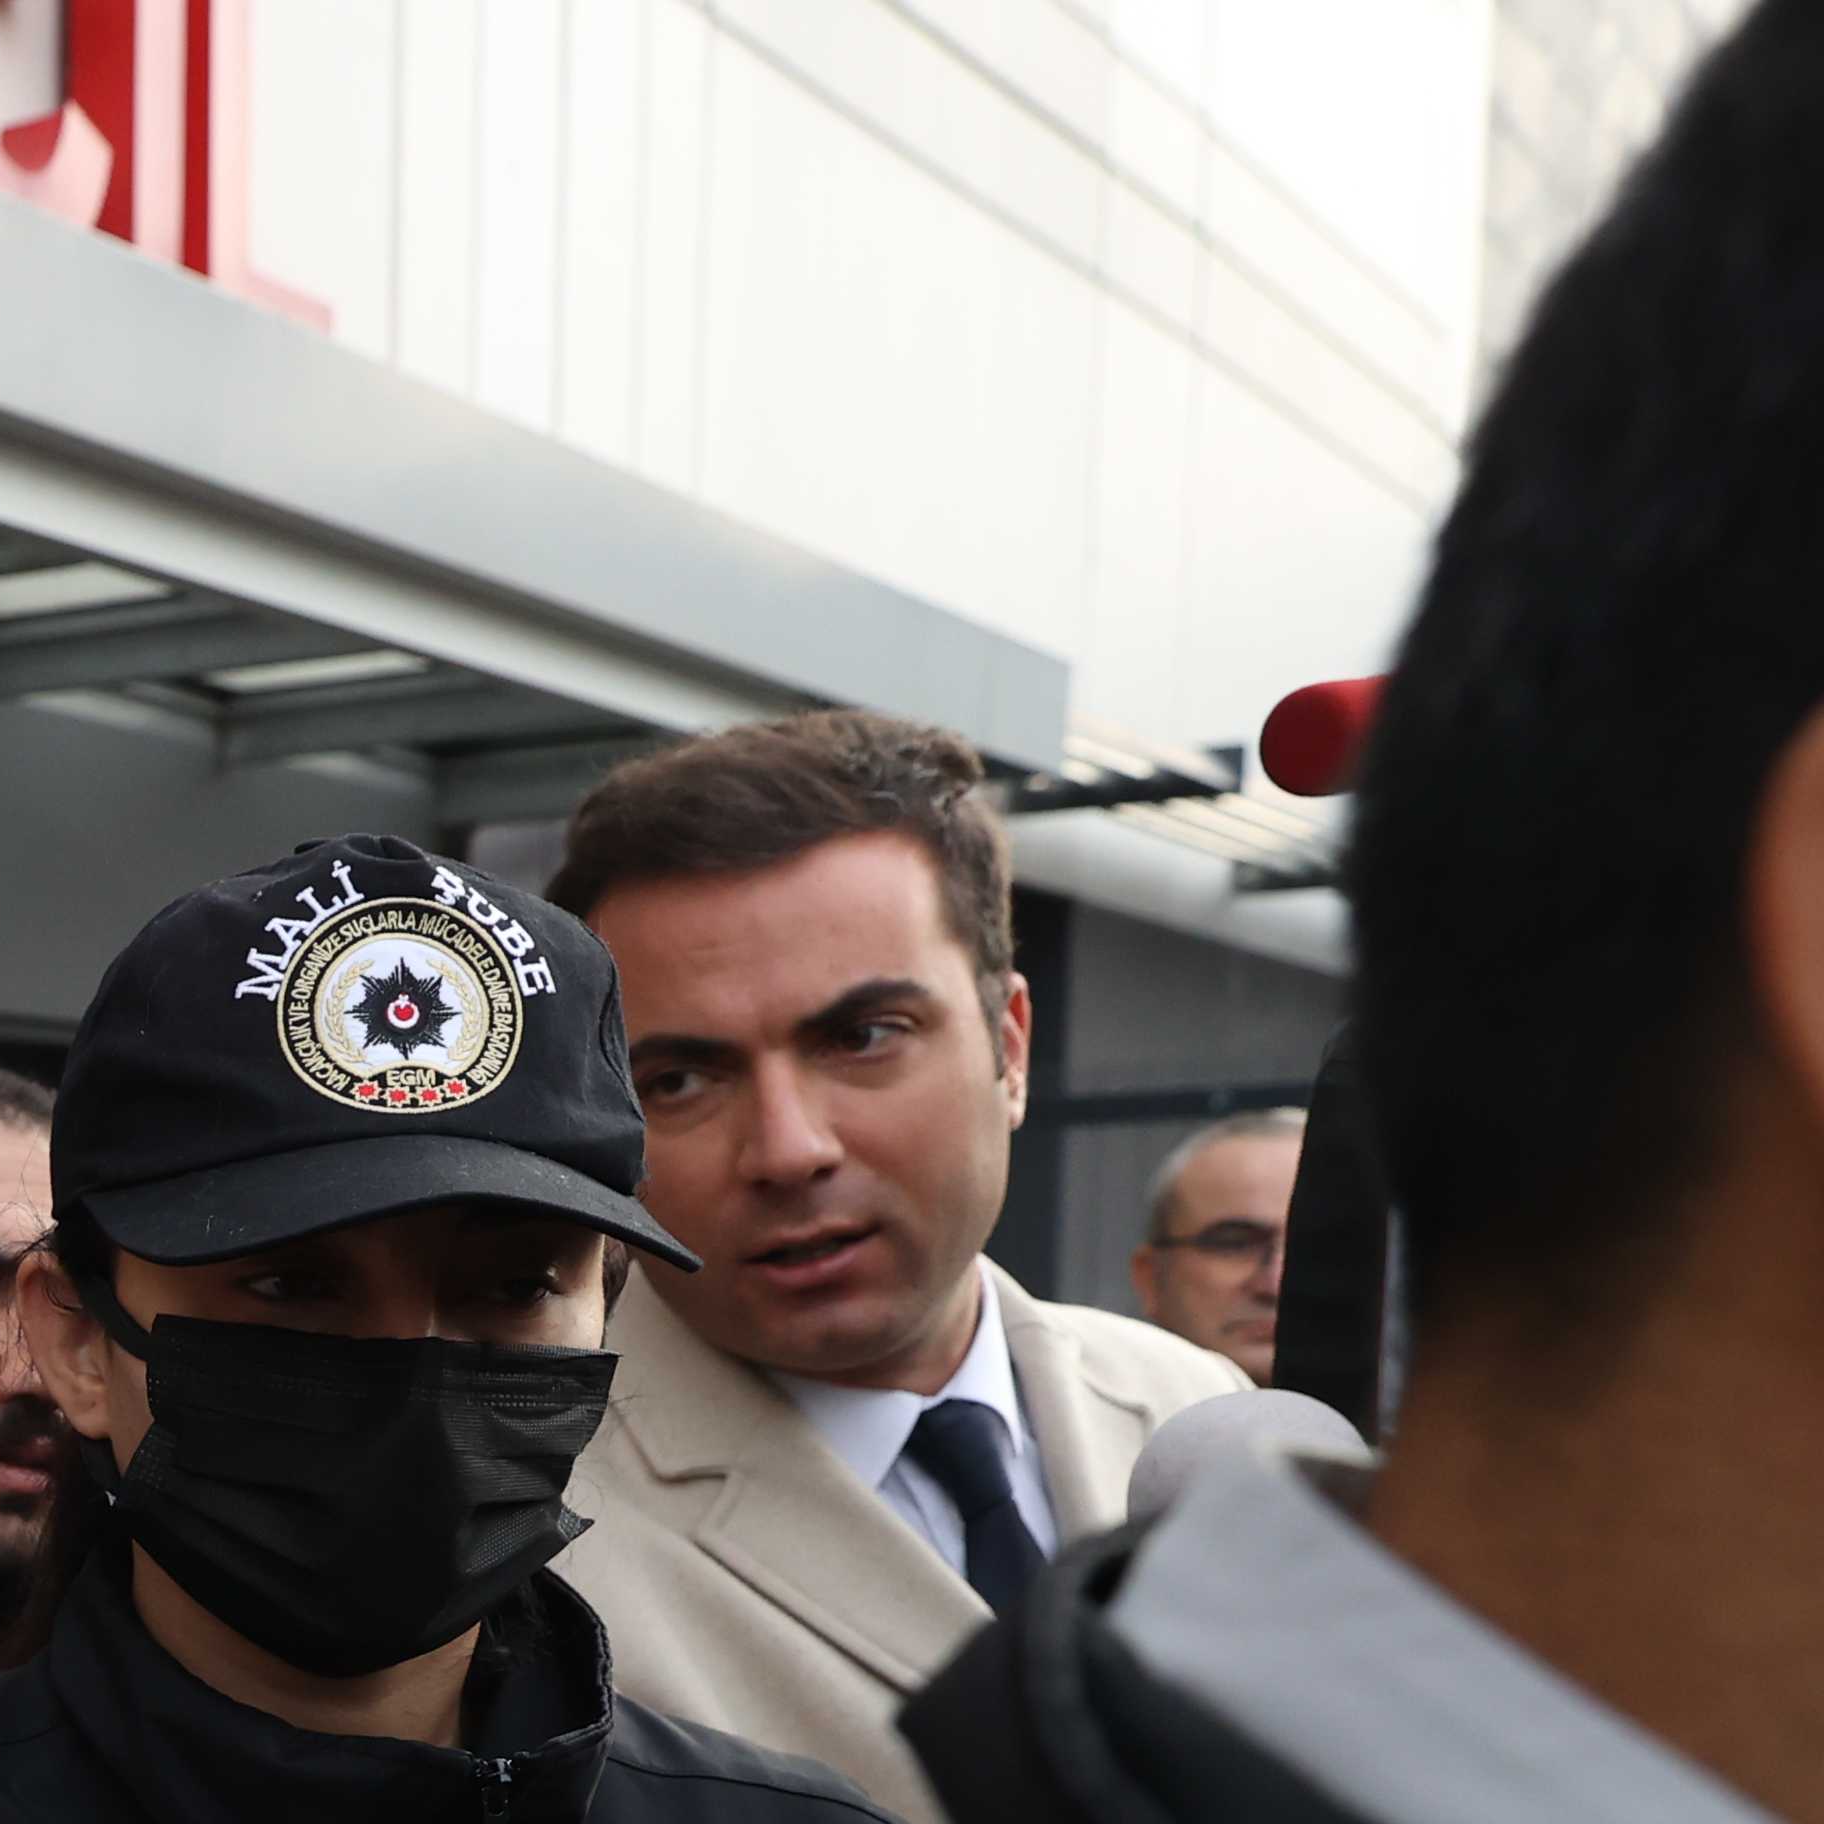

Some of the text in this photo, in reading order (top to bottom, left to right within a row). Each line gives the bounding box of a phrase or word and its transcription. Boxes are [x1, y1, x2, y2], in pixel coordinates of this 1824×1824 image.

[234, 859, 558, 1001] MALİ ŞUBE
[385, 1069, 437, 1088] EGM
